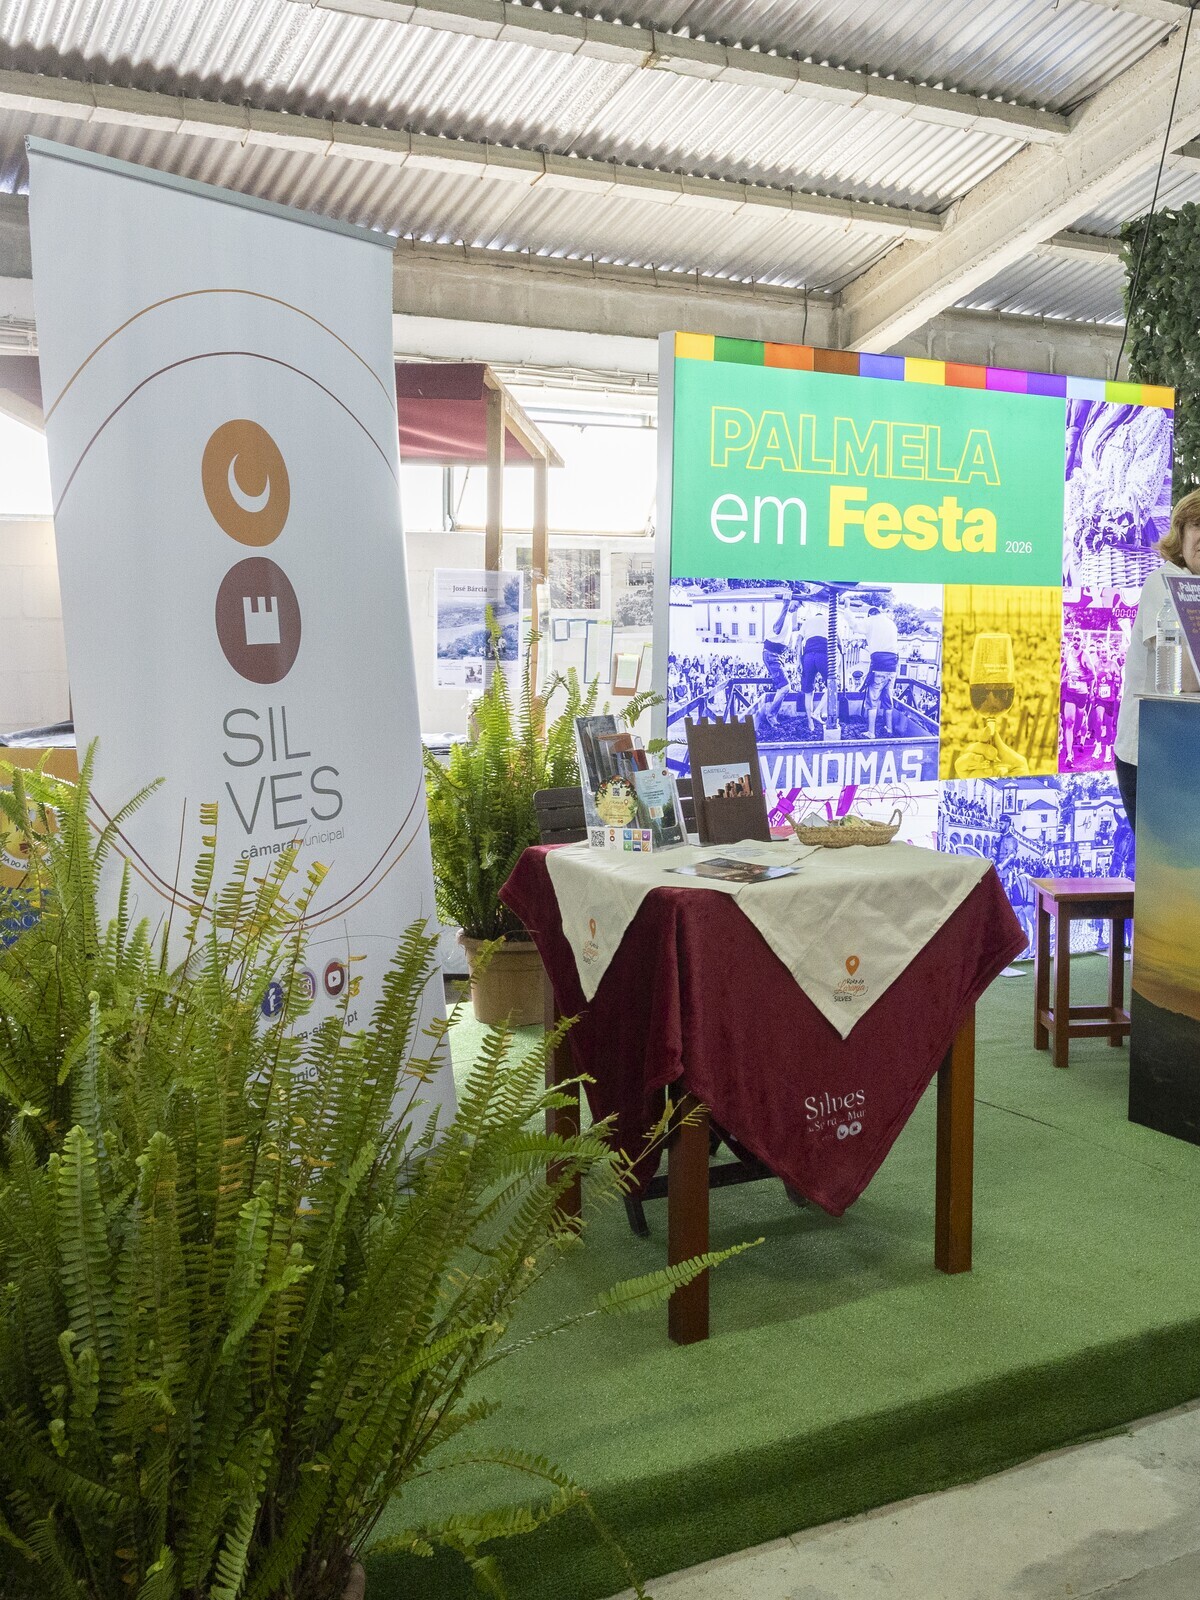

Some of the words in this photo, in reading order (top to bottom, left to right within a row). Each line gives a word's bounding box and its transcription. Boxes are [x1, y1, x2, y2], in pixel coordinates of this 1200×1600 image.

[711, 405, 1001, 486] PALMELA
[710, 493, 807, 546] em
[828, 484, 997, 553] Festa
[1004, 540, 1033, 554] 2026
[452, 585, 467, 593] José
[467, 585, 488, 593] Bárcia
[222, 705, 312, 768] SIL
[225, 765, 343, 835] VES
[759, 749, 924, 790] VINDIMAS
[804, 1089, 865, 1120] Silves
